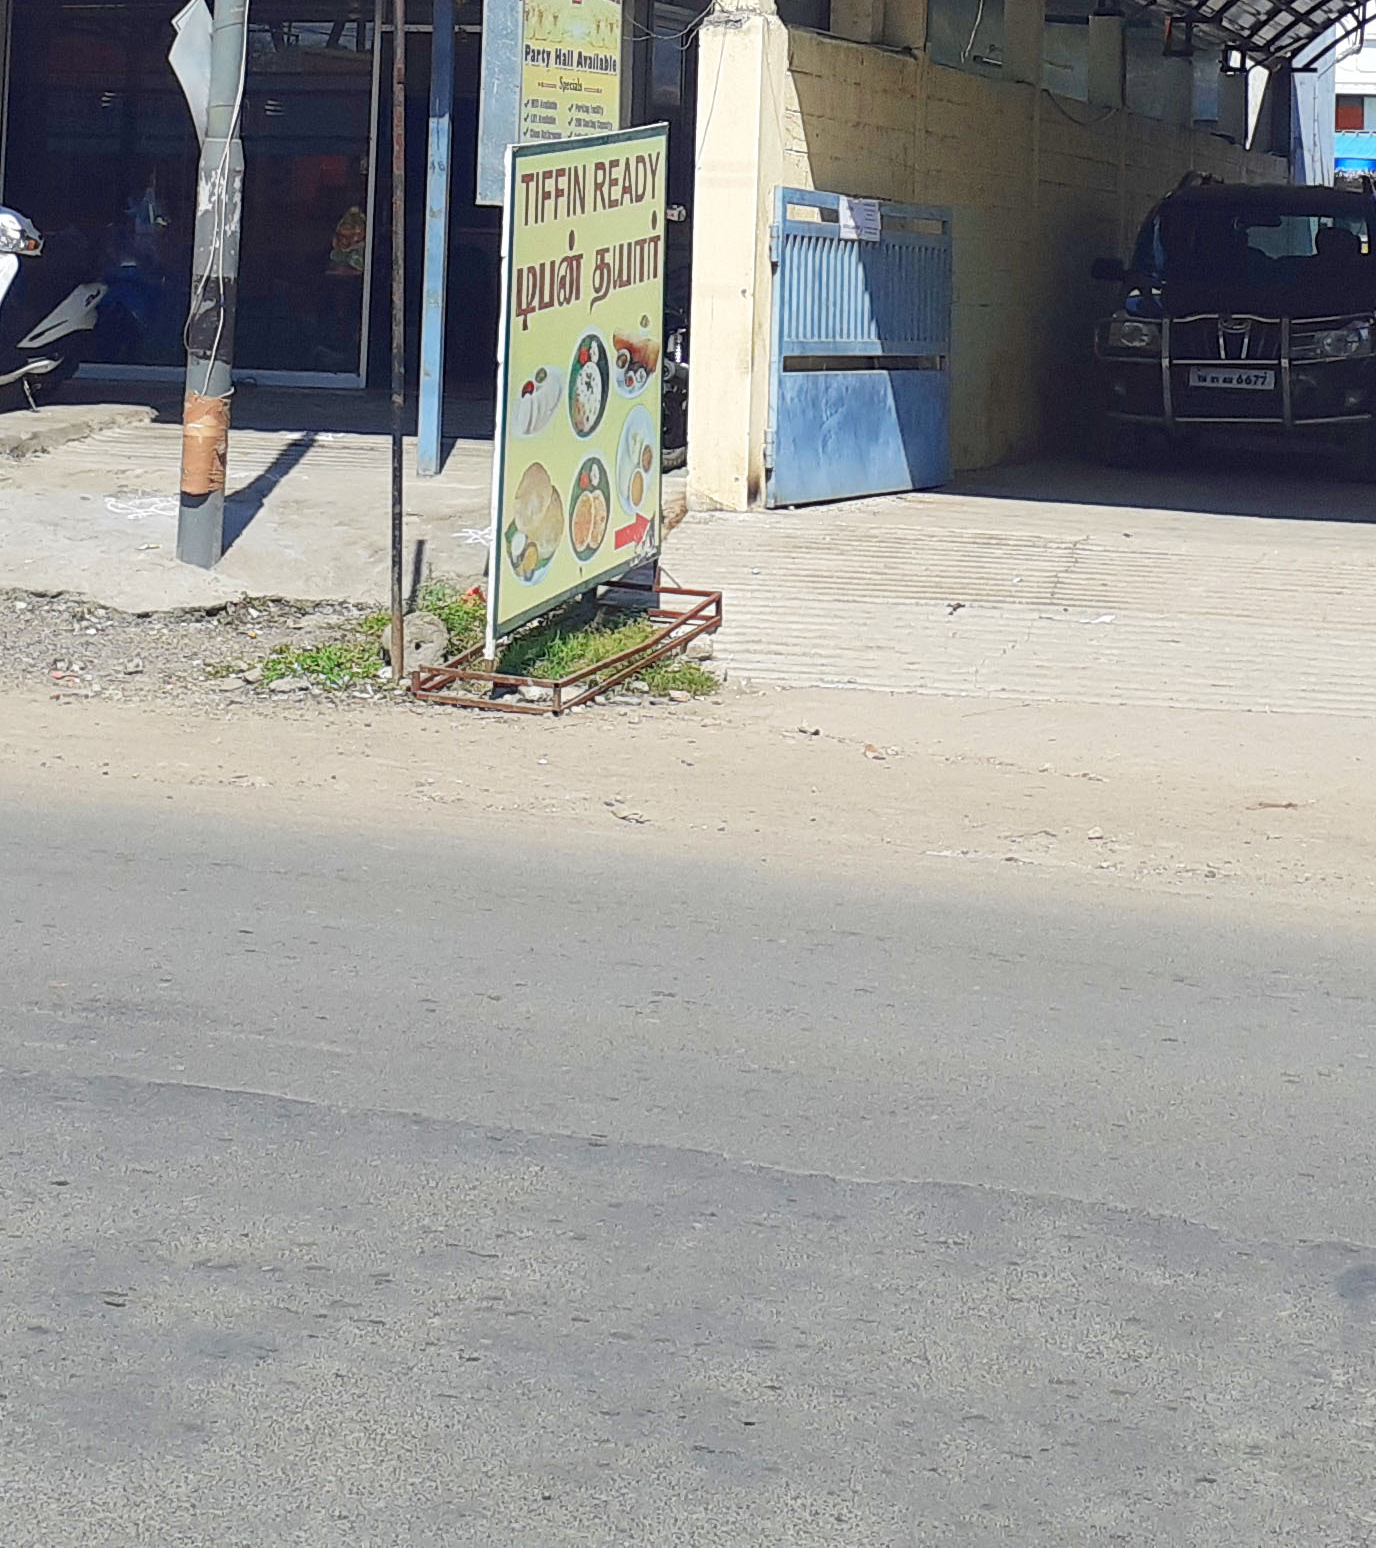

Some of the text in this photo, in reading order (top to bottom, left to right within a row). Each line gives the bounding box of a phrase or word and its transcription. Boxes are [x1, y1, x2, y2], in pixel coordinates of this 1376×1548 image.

[524, 43, 617, 73] Party Hall Available
[520, 152, 662, 227] TIFFIN READY
[515, 210, 662, 332] டிபன் தயார்
[1236, 373, 1268, 386] 6677
